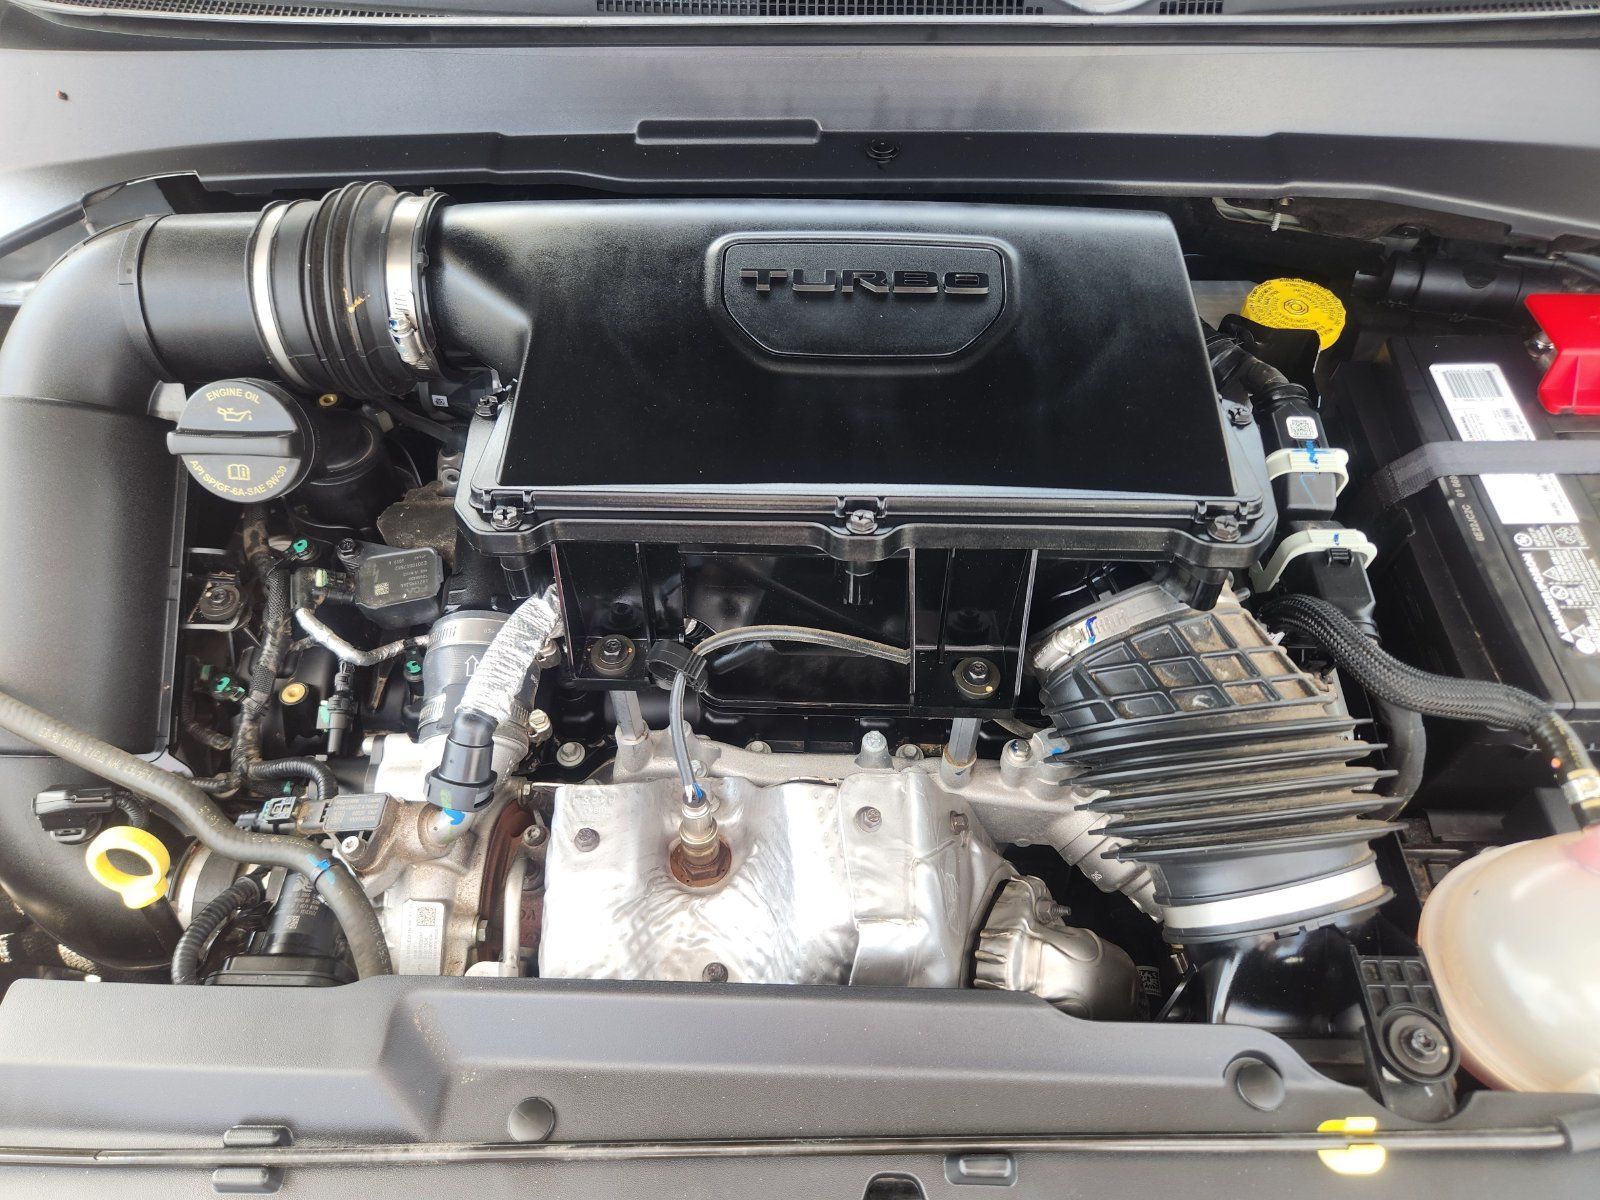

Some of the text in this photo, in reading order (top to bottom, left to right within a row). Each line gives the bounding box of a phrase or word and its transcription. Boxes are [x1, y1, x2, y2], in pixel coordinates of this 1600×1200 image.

[740, 268, 990, 294] TURBO
[205, 387, 261, 405] ENGINE OIL
[190, 460, 206, 476] API
